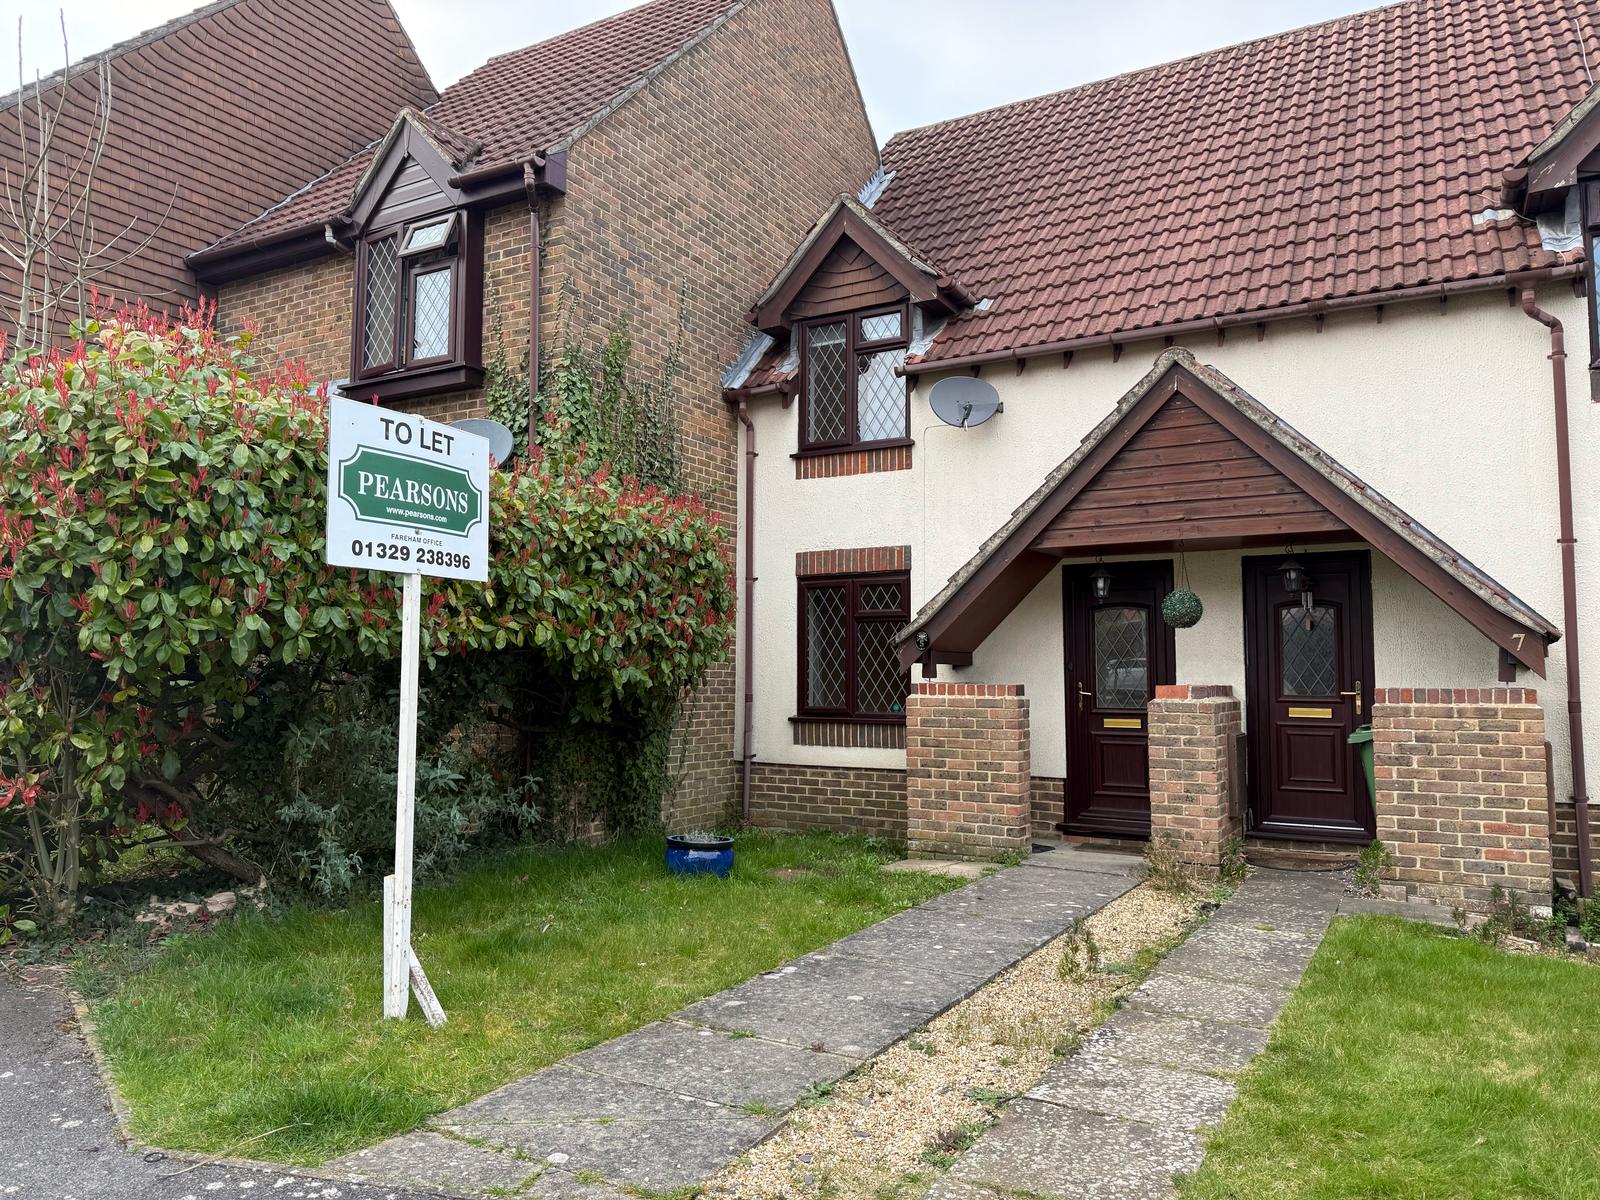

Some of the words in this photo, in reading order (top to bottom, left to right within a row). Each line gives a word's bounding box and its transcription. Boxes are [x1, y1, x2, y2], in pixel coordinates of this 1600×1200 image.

[380, 417, 413, 445] TO
[420, 427, 454, 456] LET
[358, 470, 468, 514] PEARSONS
[386, 506, 448, 524] www.pearsons.com
[391, 533, 422, 544] FAREHAM
[423, 537, 443, 547] OFFICE
[351, 539, 411, 562] 01329
[416, 547, 471, 570] 238396
[1511, 633, 1526, 651] 7
